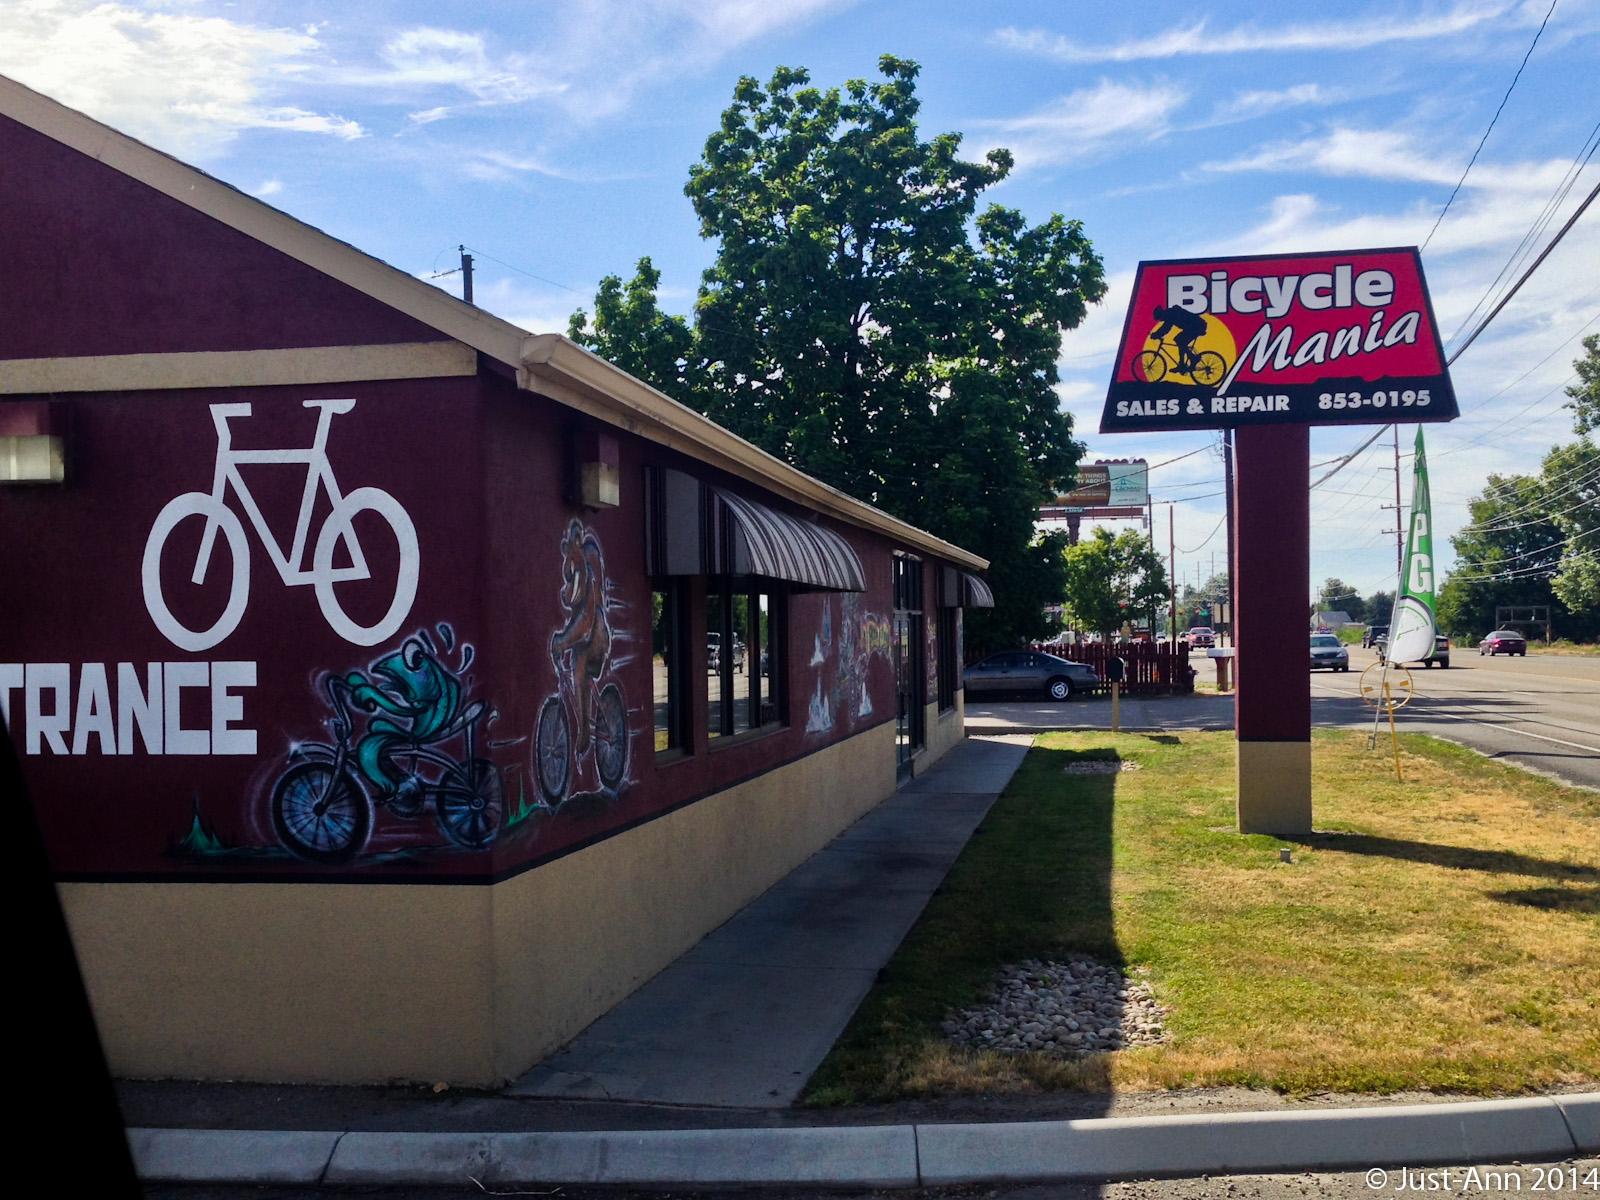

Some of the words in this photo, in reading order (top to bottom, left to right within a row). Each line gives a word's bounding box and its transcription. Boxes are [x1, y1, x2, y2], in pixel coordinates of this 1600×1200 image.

[1167, 265, 1394, 318] Bicycle
[1217, 311, 1420, 396] Mania
[1116, 399, 1180, 417] SALES
[1186, 398, 1204, 415] &
[1211, 395, 1290, 414] REPAIR
[1318, 390, 1431, 409] 853-0195
